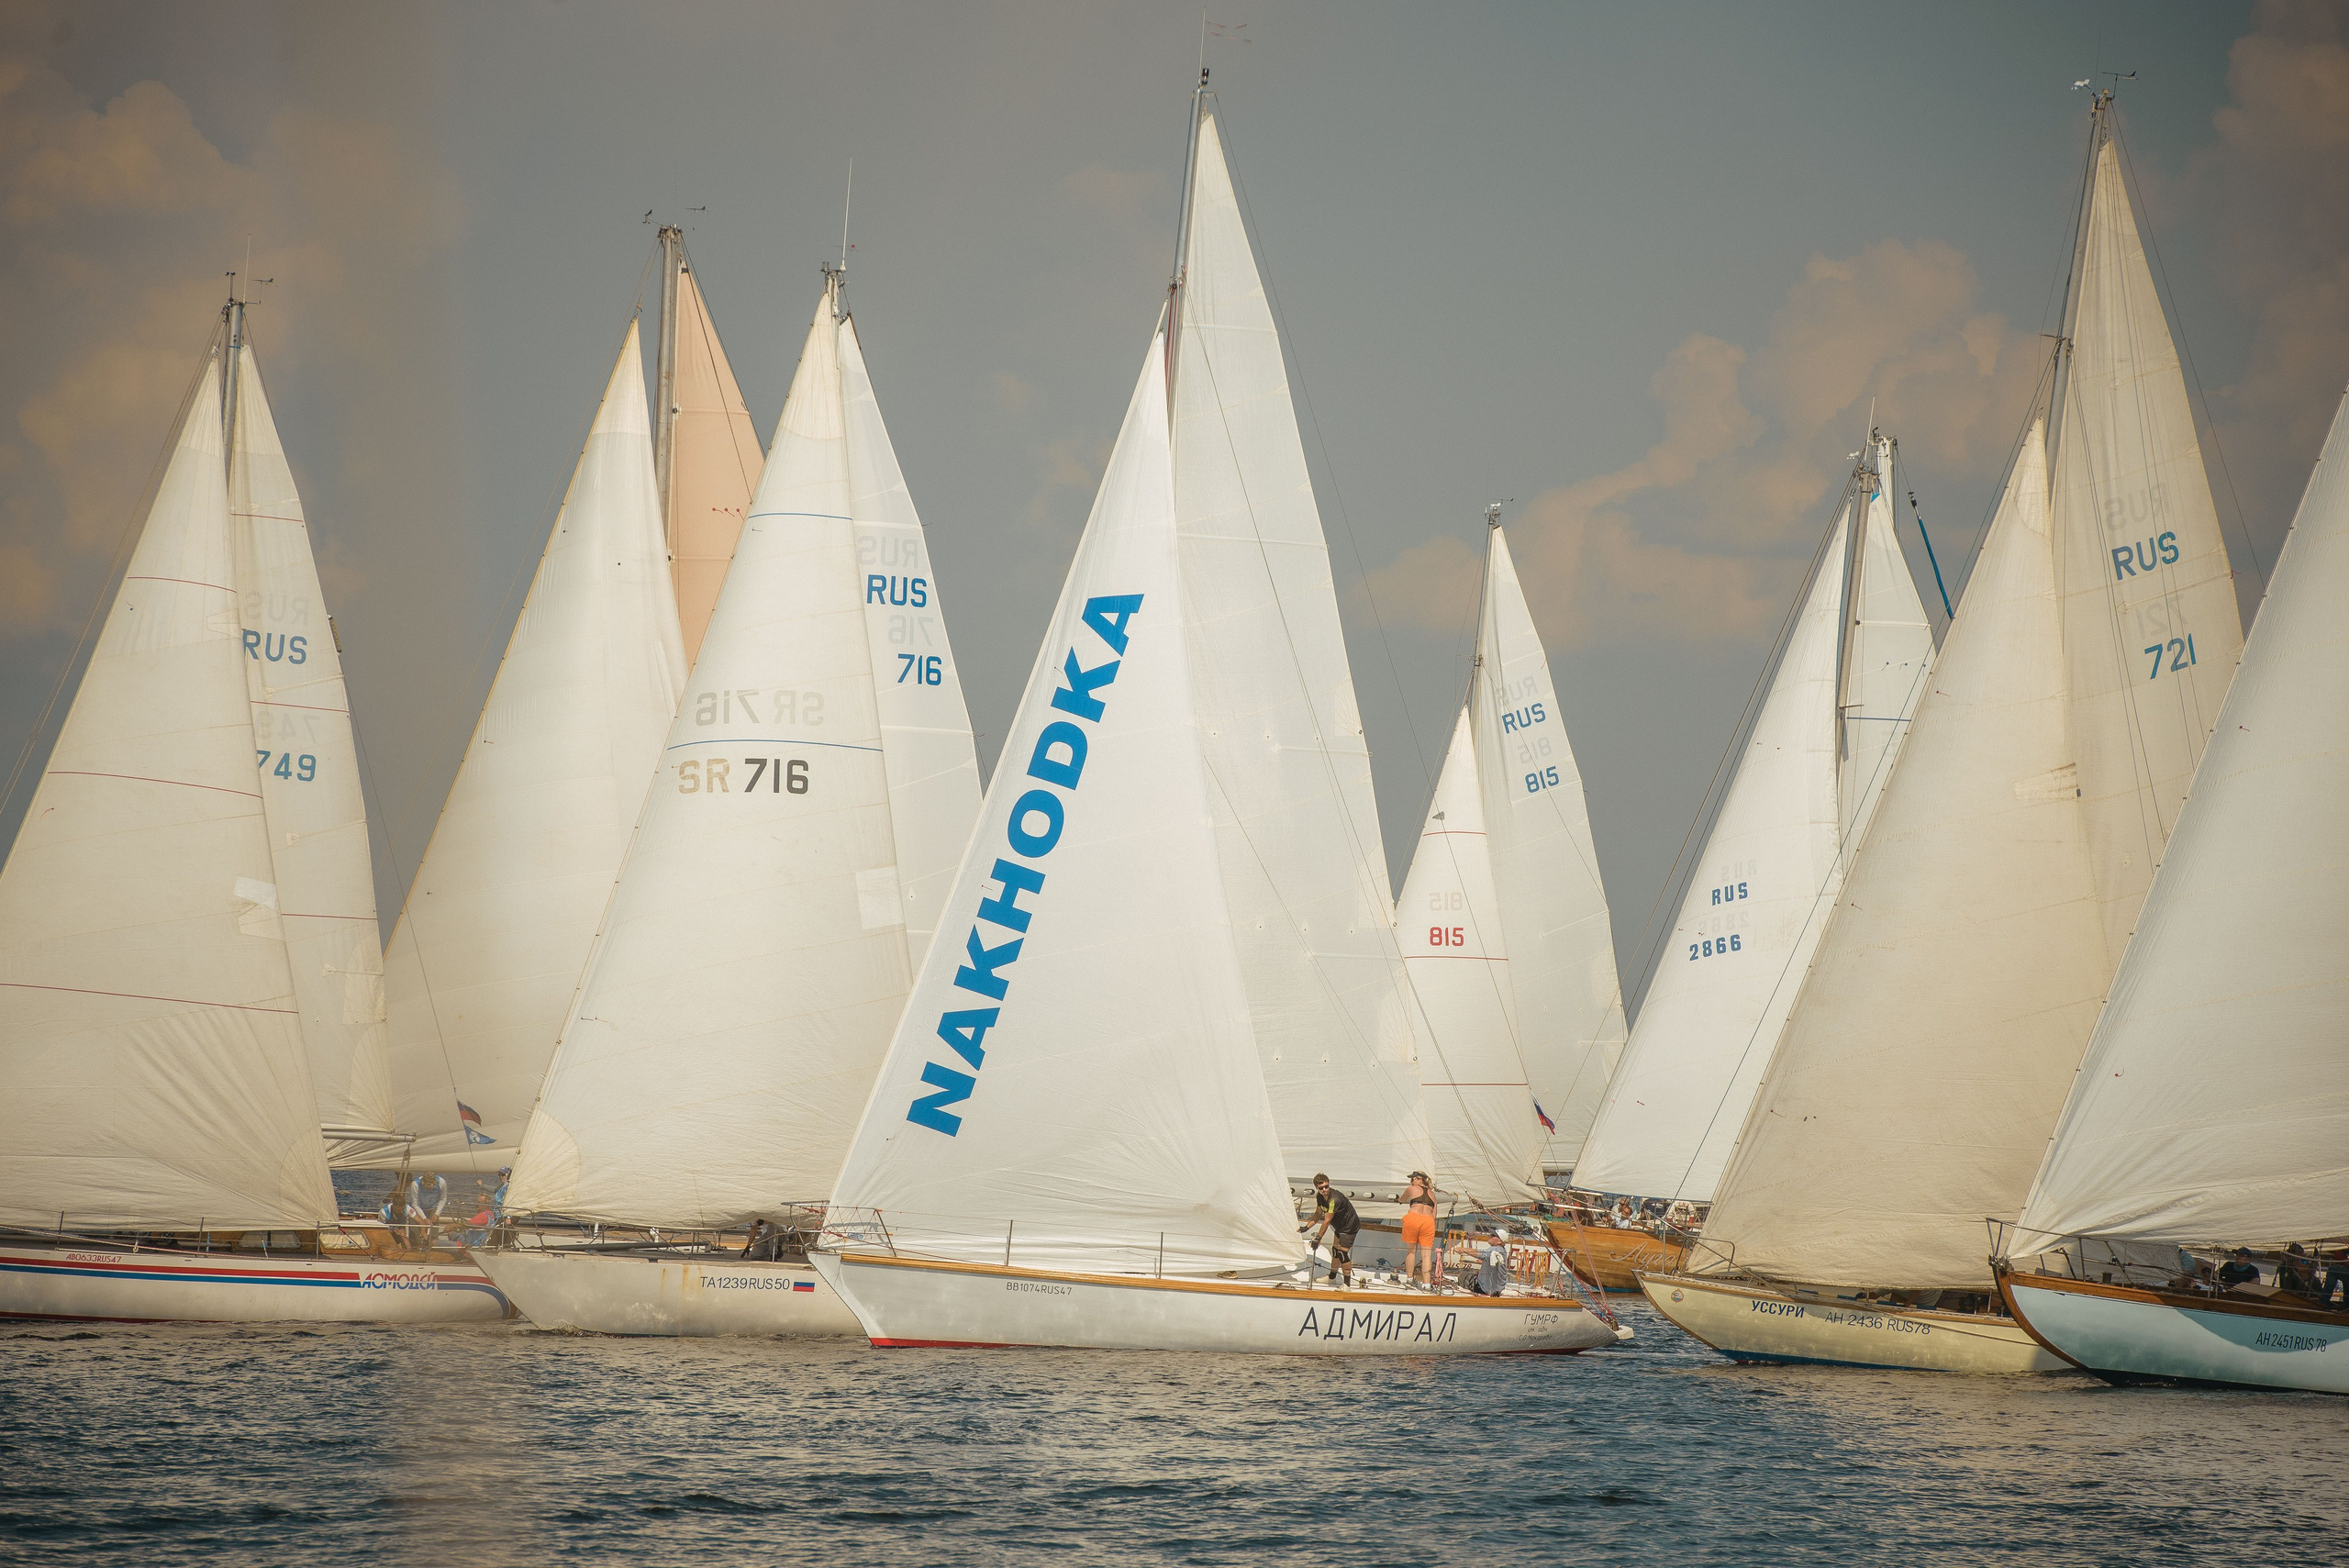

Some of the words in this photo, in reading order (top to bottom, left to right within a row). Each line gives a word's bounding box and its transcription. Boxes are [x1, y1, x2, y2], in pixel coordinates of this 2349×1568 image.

[2111, 531, 2179, 581] RUS
[866, 574, 927, 607] RUS
[242, 628, 307, 664] RUS
[2144, 633, 2197, 680] 721
[897, 653, 942, 685] 716
[1502, 703, 1546, 734] RUS
[256, 750, 317, 782] 749
[679, 758, 730, 794] SR
[744, 758, 809, 795] 716
[1525, 766, 1559, 793] 815
[907, 594, 1145, 1138] NAKHODKA
[1711, 882, 1748, 906] RUS
[1430, 927, 1464, 946] 815
[1689, 934, 1742, 961] 2866
[1298, 1307, 1457, 1342] АДМИРАЛ
[1524, 1313, 1559, 1325] ГУМРФ
[1752, 1300, 1805, 1318] УССУРИ
[1847, 1314, 1883, 1329] 2436
